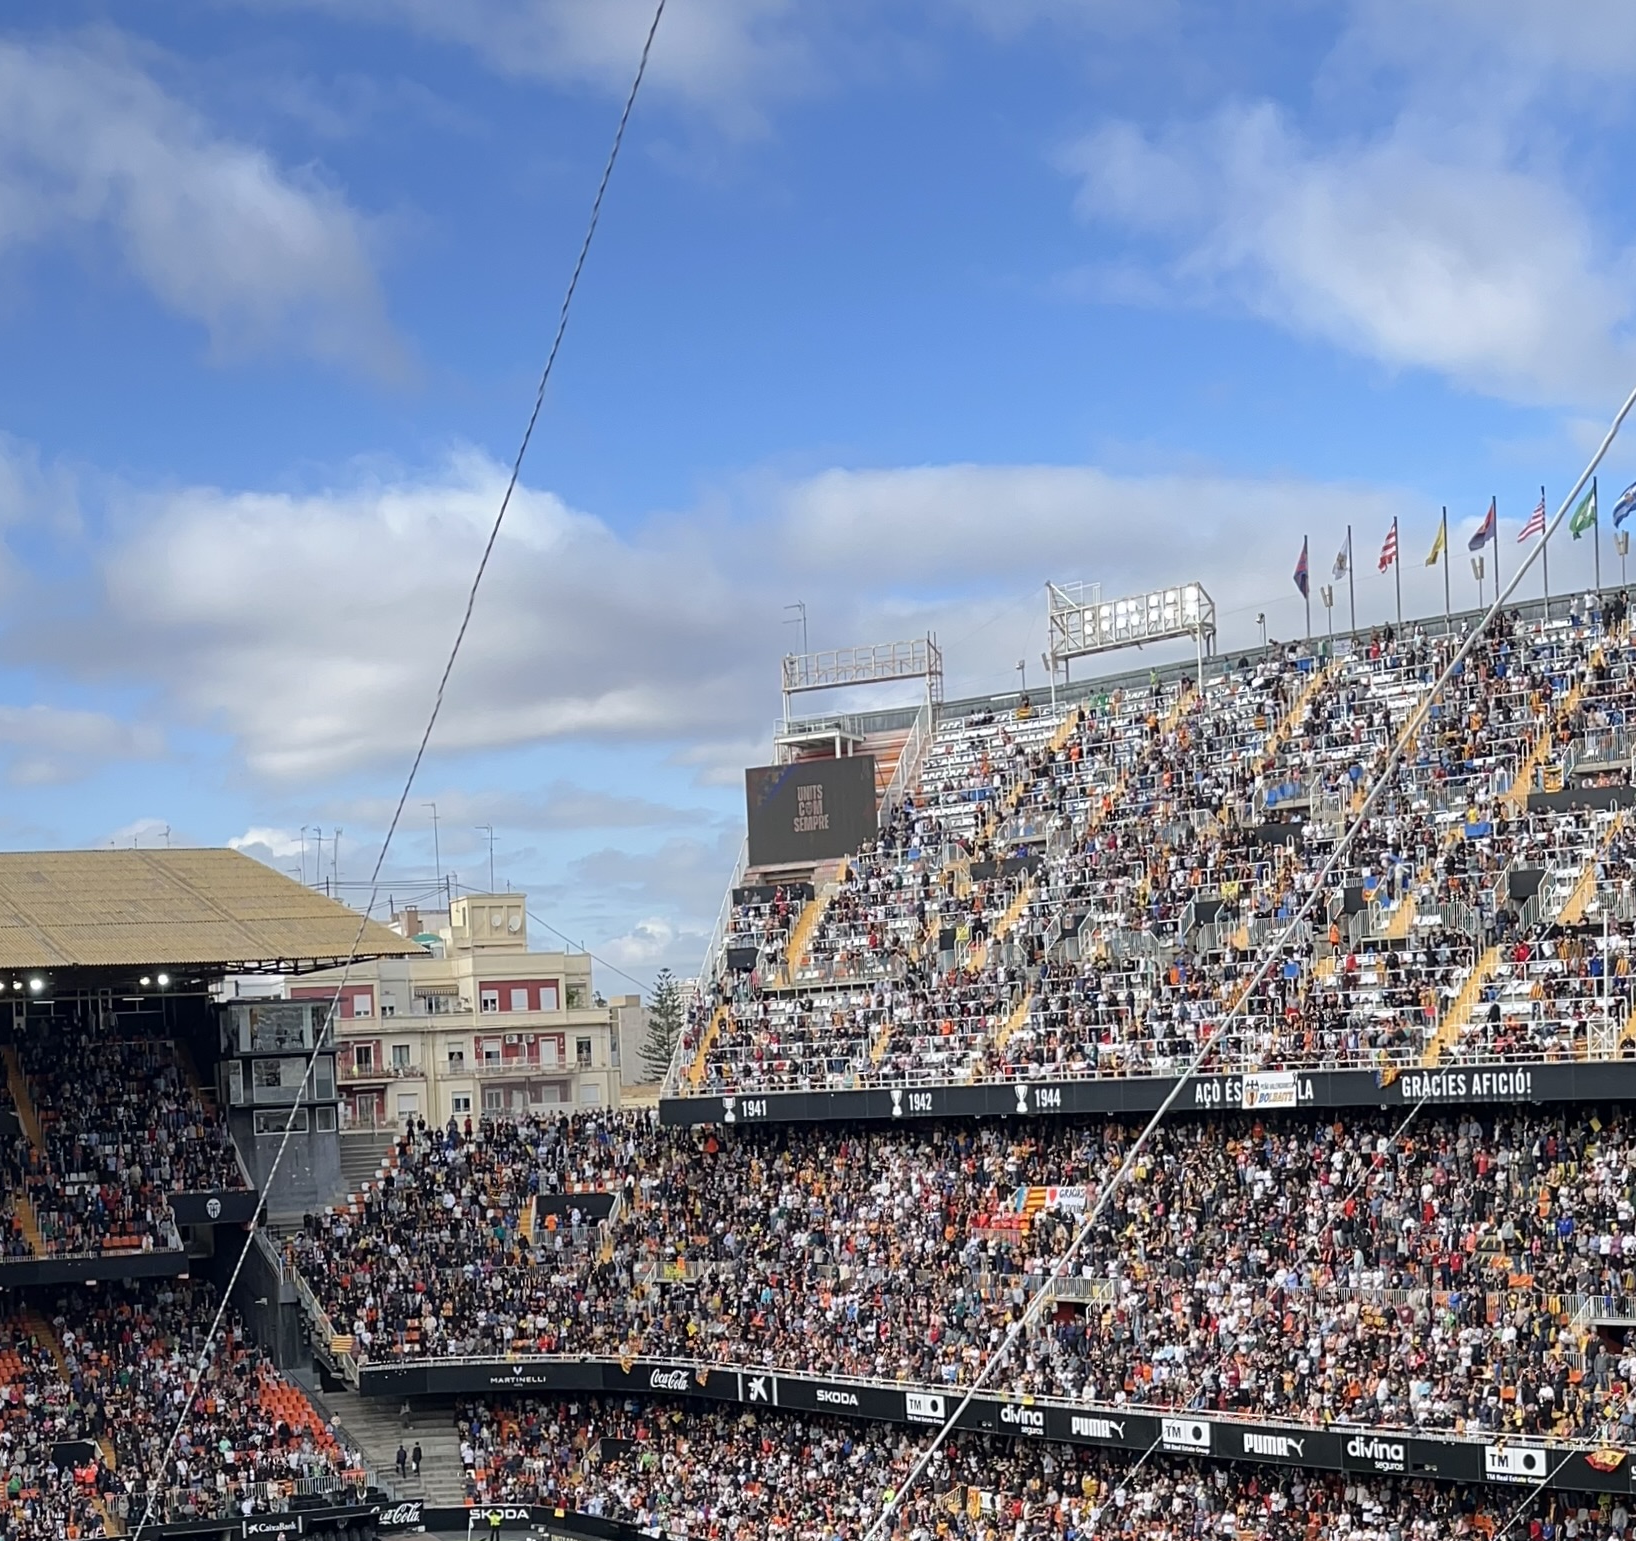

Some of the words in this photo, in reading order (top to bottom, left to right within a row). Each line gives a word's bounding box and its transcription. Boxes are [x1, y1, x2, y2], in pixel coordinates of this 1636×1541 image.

[797, 784, 823, 801] UNITS
[793, 814, 830, 832] SEMPRE
[1195, 1078, 1221, 1108] AÇÒ
[1225, 1075, 1242, 1103] ÉS
[1401, 1068, 1466, 1098] GRÀCIES
[1471, 1067, 1532, 1096] AFICIÓ!
[907, 1092, 933, 1112] 1942
[1035, 1087, 1062, 1108] 1944
[741, 1099, 767, 1118] 1941
[489, 1375, 547, 1384] MARTINELLI
[908, 1399, 922, 1411] TM
[1000, 1403, 1044, 1426] divina
[1021, 1424, 1044, 1436] seguros
[1071, 1416, 1112, 1438] PUMA
[1166, 1426, 1181, 1439] TM
[1244, 1433, 1288, 1457] PUMA
[1347, 1436, 1405, 1461] divina
[1374, 1459, 1405, 1471] seguros
[259, 1520, 297, 1534] CaixaBank
